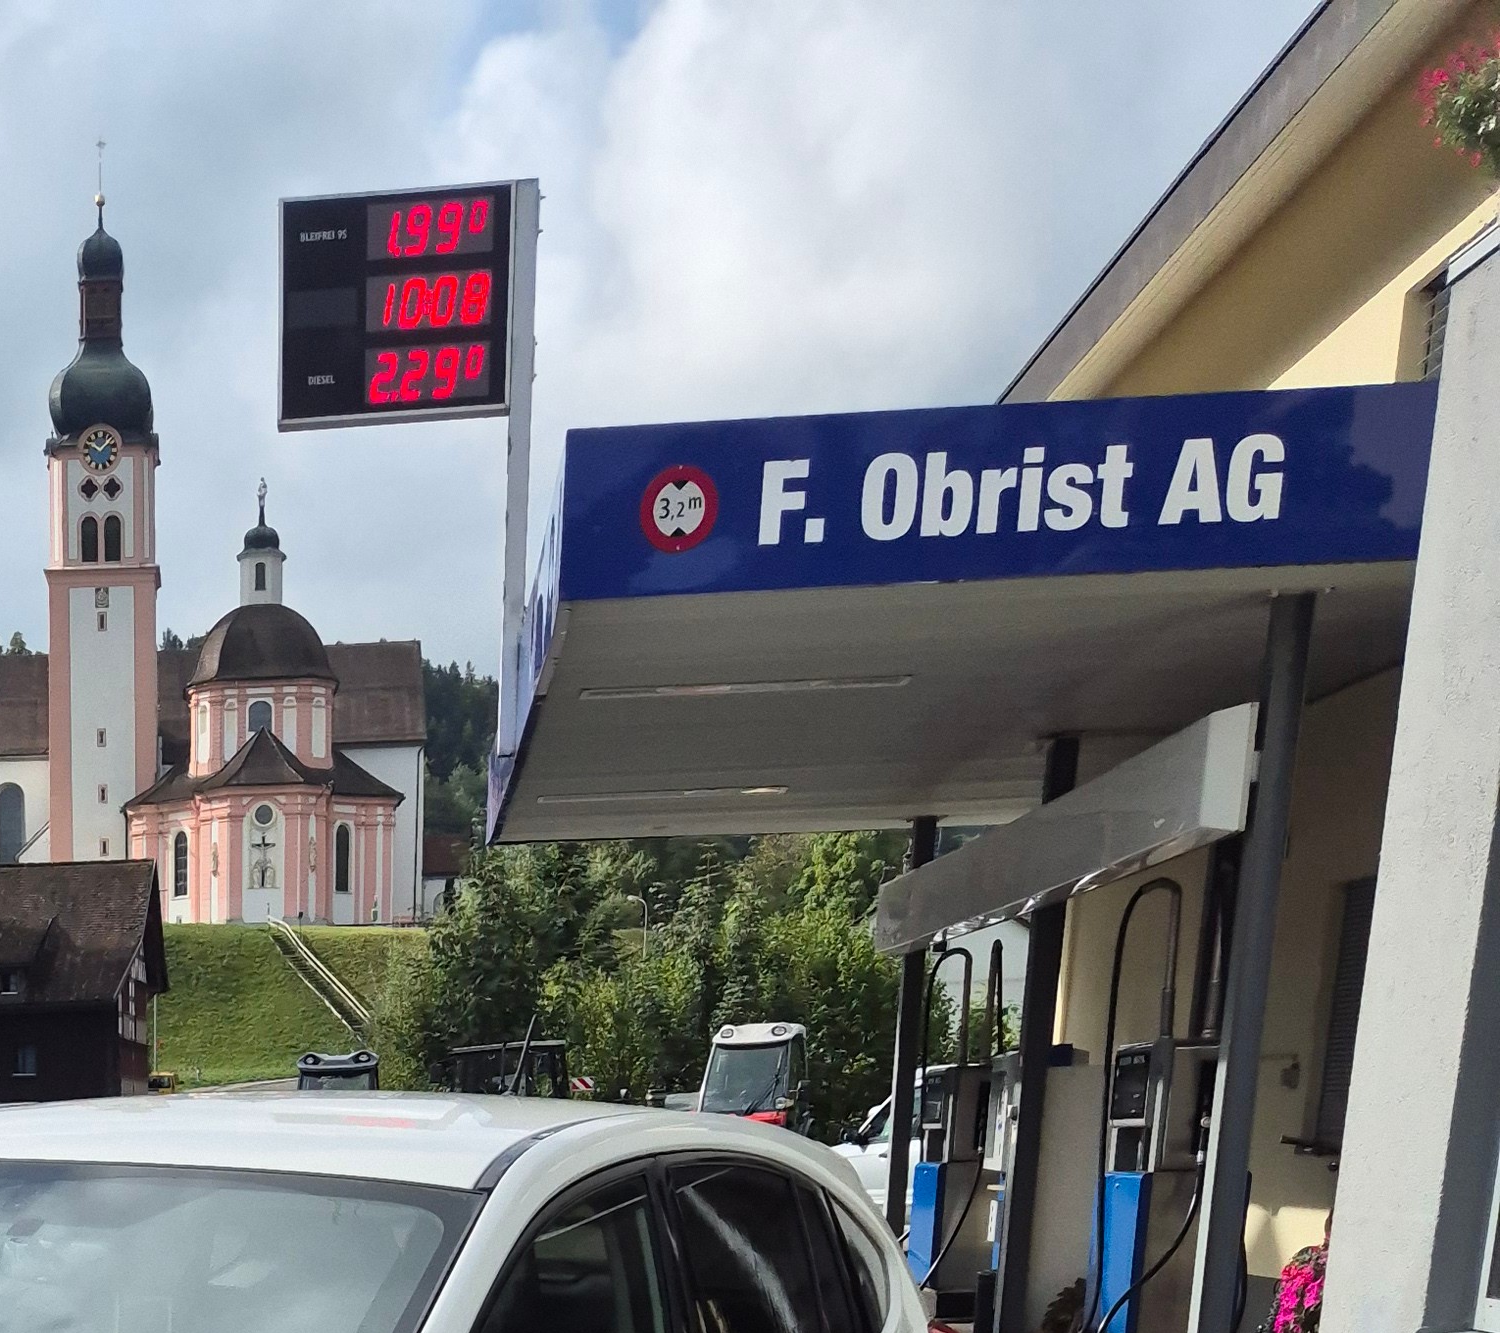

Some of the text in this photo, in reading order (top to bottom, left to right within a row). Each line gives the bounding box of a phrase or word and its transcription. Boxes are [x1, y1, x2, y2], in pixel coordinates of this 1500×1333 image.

[300, 229, 347, 242] BLEIFREI 95
[308, 375, 335, 385] DIESEL
[758, 433, 1285, 546] F. Obrist AG
